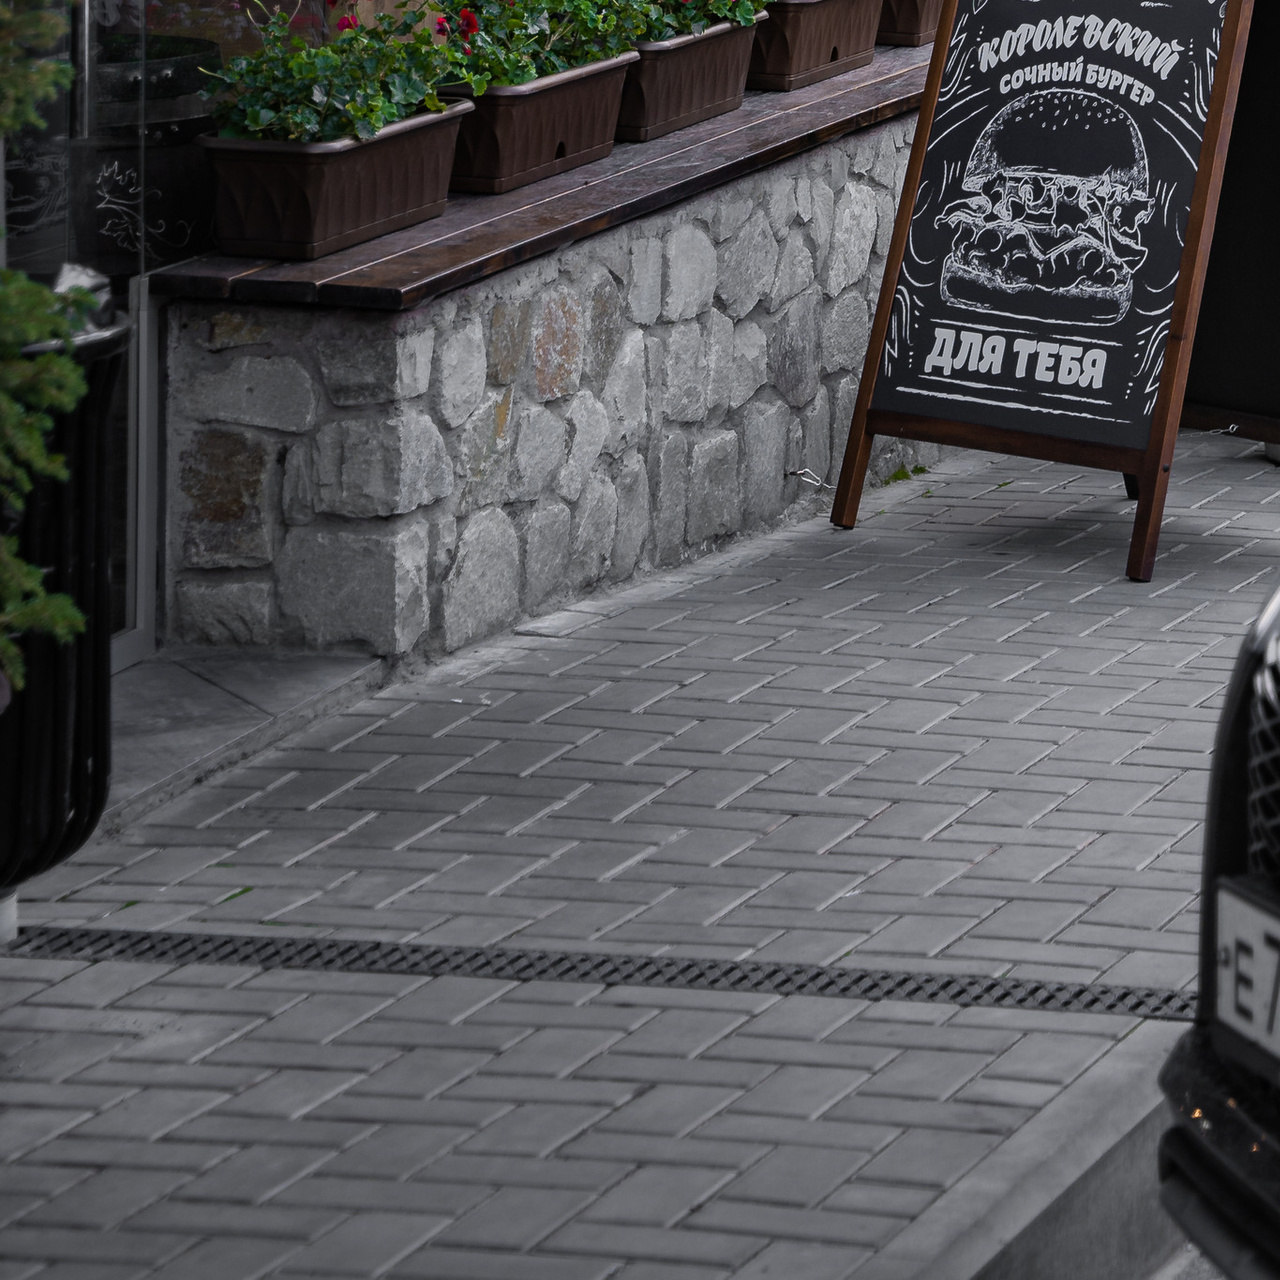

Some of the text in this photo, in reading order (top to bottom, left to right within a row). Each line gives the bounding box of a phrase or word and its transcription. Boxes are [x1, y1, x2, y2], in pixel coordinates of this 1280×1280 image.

[978, 14, 1185, 80] КОРОЛЕВСКИЙ
[1000, 55, 1155, 106] СОЧНЫЙ БУРГЕР
[924, 327, 1107, 389] ДЛЯ ТЕБЯ
